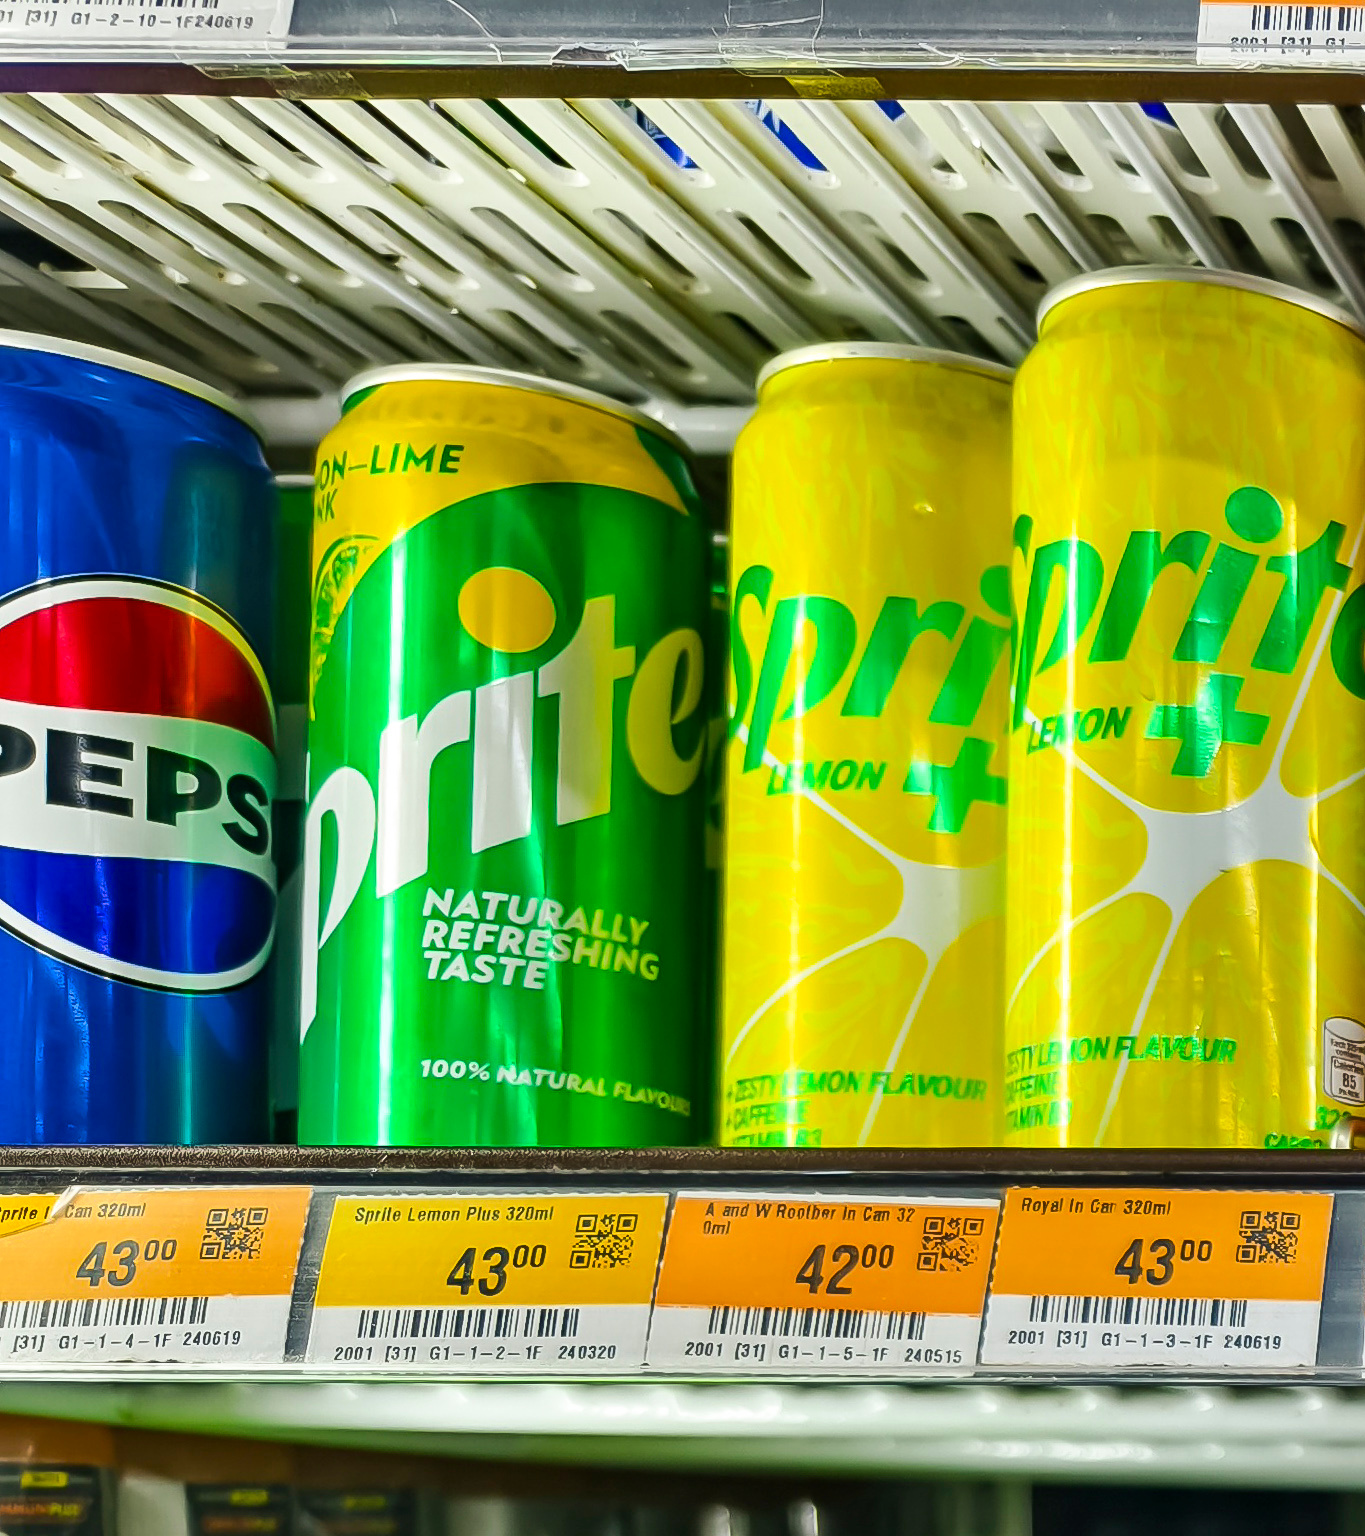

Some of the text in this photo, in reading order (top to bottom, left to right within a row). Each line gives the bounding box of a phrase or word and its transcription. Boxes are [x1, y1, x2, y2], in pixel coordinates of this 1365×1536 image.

[1027, 706, 1133, 755] LEMON
[766, 760, 885, 796] LEMON
[422, 886, 649, 947] NATURALLY
[422, 920, 660, 981] REFRESHING
[422, 950, 548, 990] TASTE
[1114, 1035, 1237, 1064] FLAVOUR
[421, 1059, 607, 1097] 100% NATURAL
[867, 1072, 987, 1100] FLAVOUR
[64, 1202, 146, 1219] Can 320ml
[408, 1208, 459, 1221] Lemon
[466, 1208, 500, 1221] Plus
[506, 1206, 554, 1221] 320ml
[705, 1202, 714, 1216] A
[722, 1203, 749, 1217] and
[756, 1204, 772, 1218] W
[863, 1207, 890, 1221] Can
[897, 1209, 915, 1222] 32
[1022, 1198, 1171, 1215] Royal Can 320ml
[334, 1345, 616, 1362] 2001 [31] 240320
